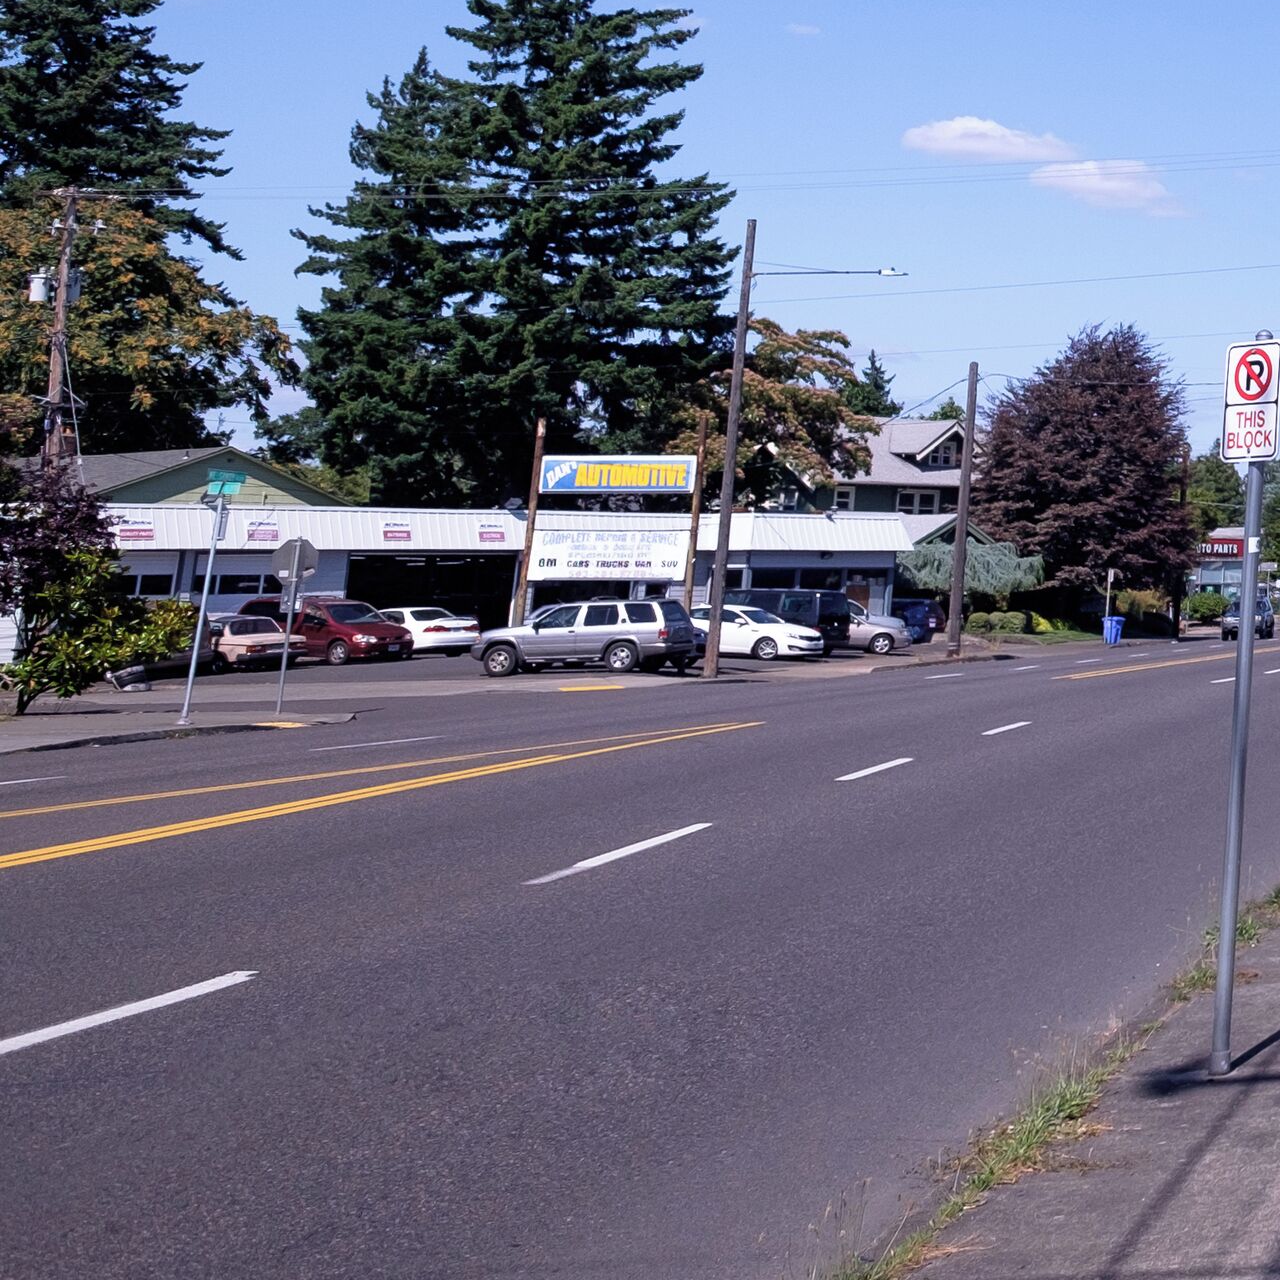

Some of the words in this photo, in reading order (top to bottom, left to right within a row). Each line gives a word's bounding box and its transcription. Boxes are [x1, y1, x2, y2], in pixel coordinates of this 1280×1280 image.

[1236, 410, 1265, 428] THIS
[1227, 430, 1273, 449] BLOCK
[575, 463, 687, 487] AUTOMOTIVE
[1213, 543, 1238, 555] PARTS
[596, 560, 630, 568] TRUCKS
[635, 560, 652, 568] VAN
[661, 560, 678, 568] SUV
